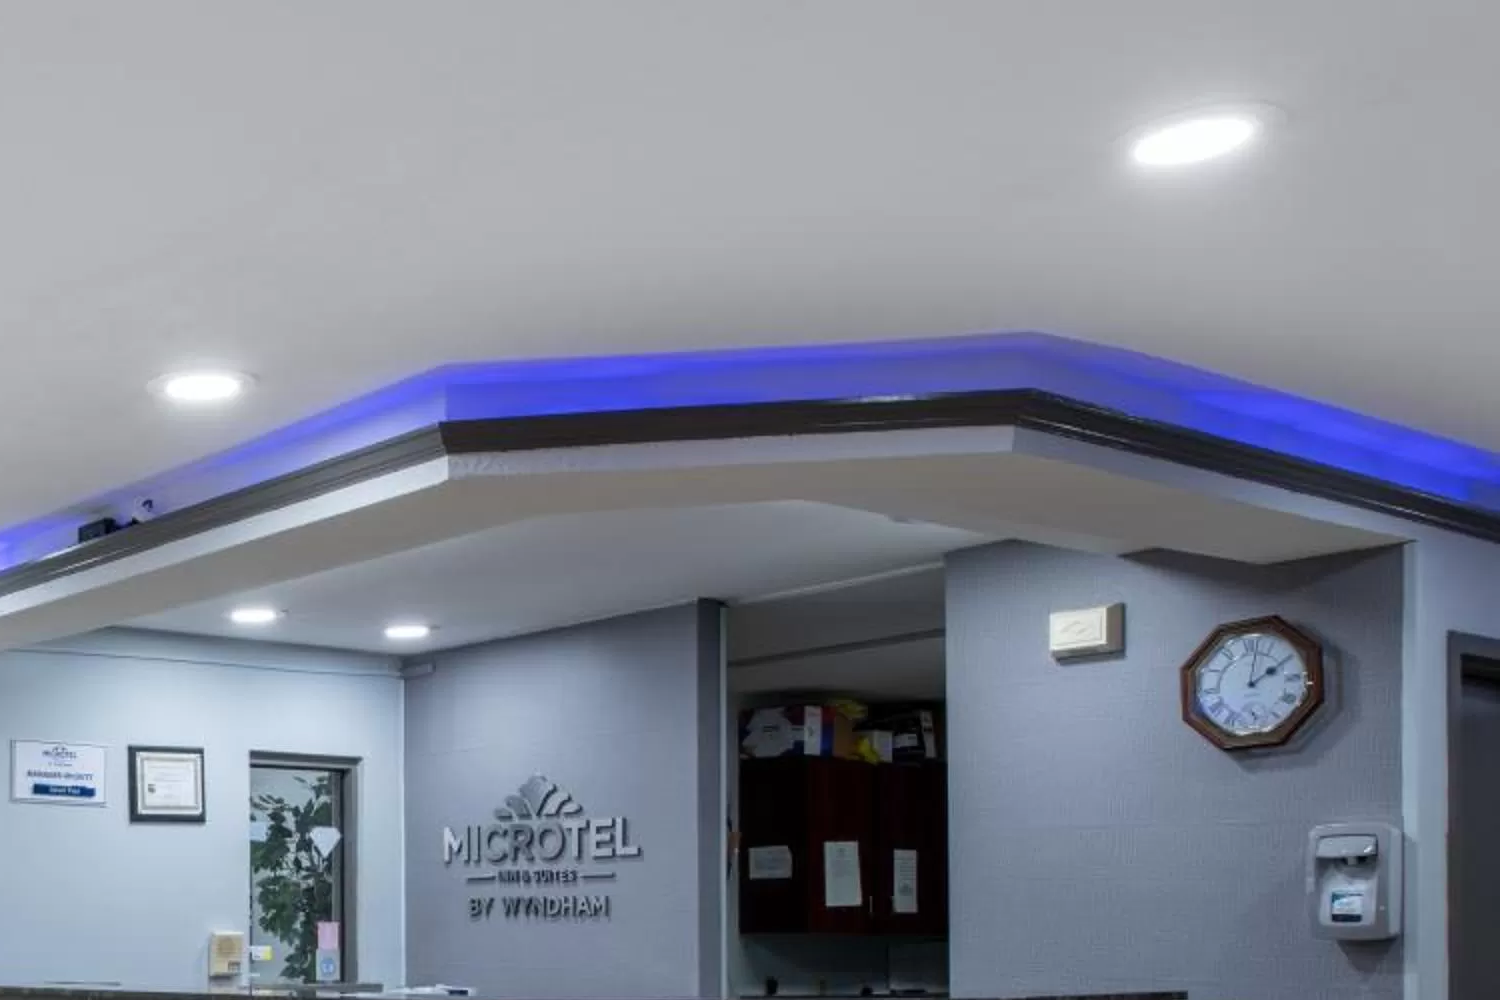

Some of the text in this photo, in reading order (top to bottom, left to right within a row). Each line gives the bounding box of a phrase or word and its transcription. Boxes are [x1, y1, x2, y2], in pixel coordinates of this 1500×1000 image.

[443, 816, 642, 868] MICROTEL
[469, 895, 611, 919] BY WYNDHAM
